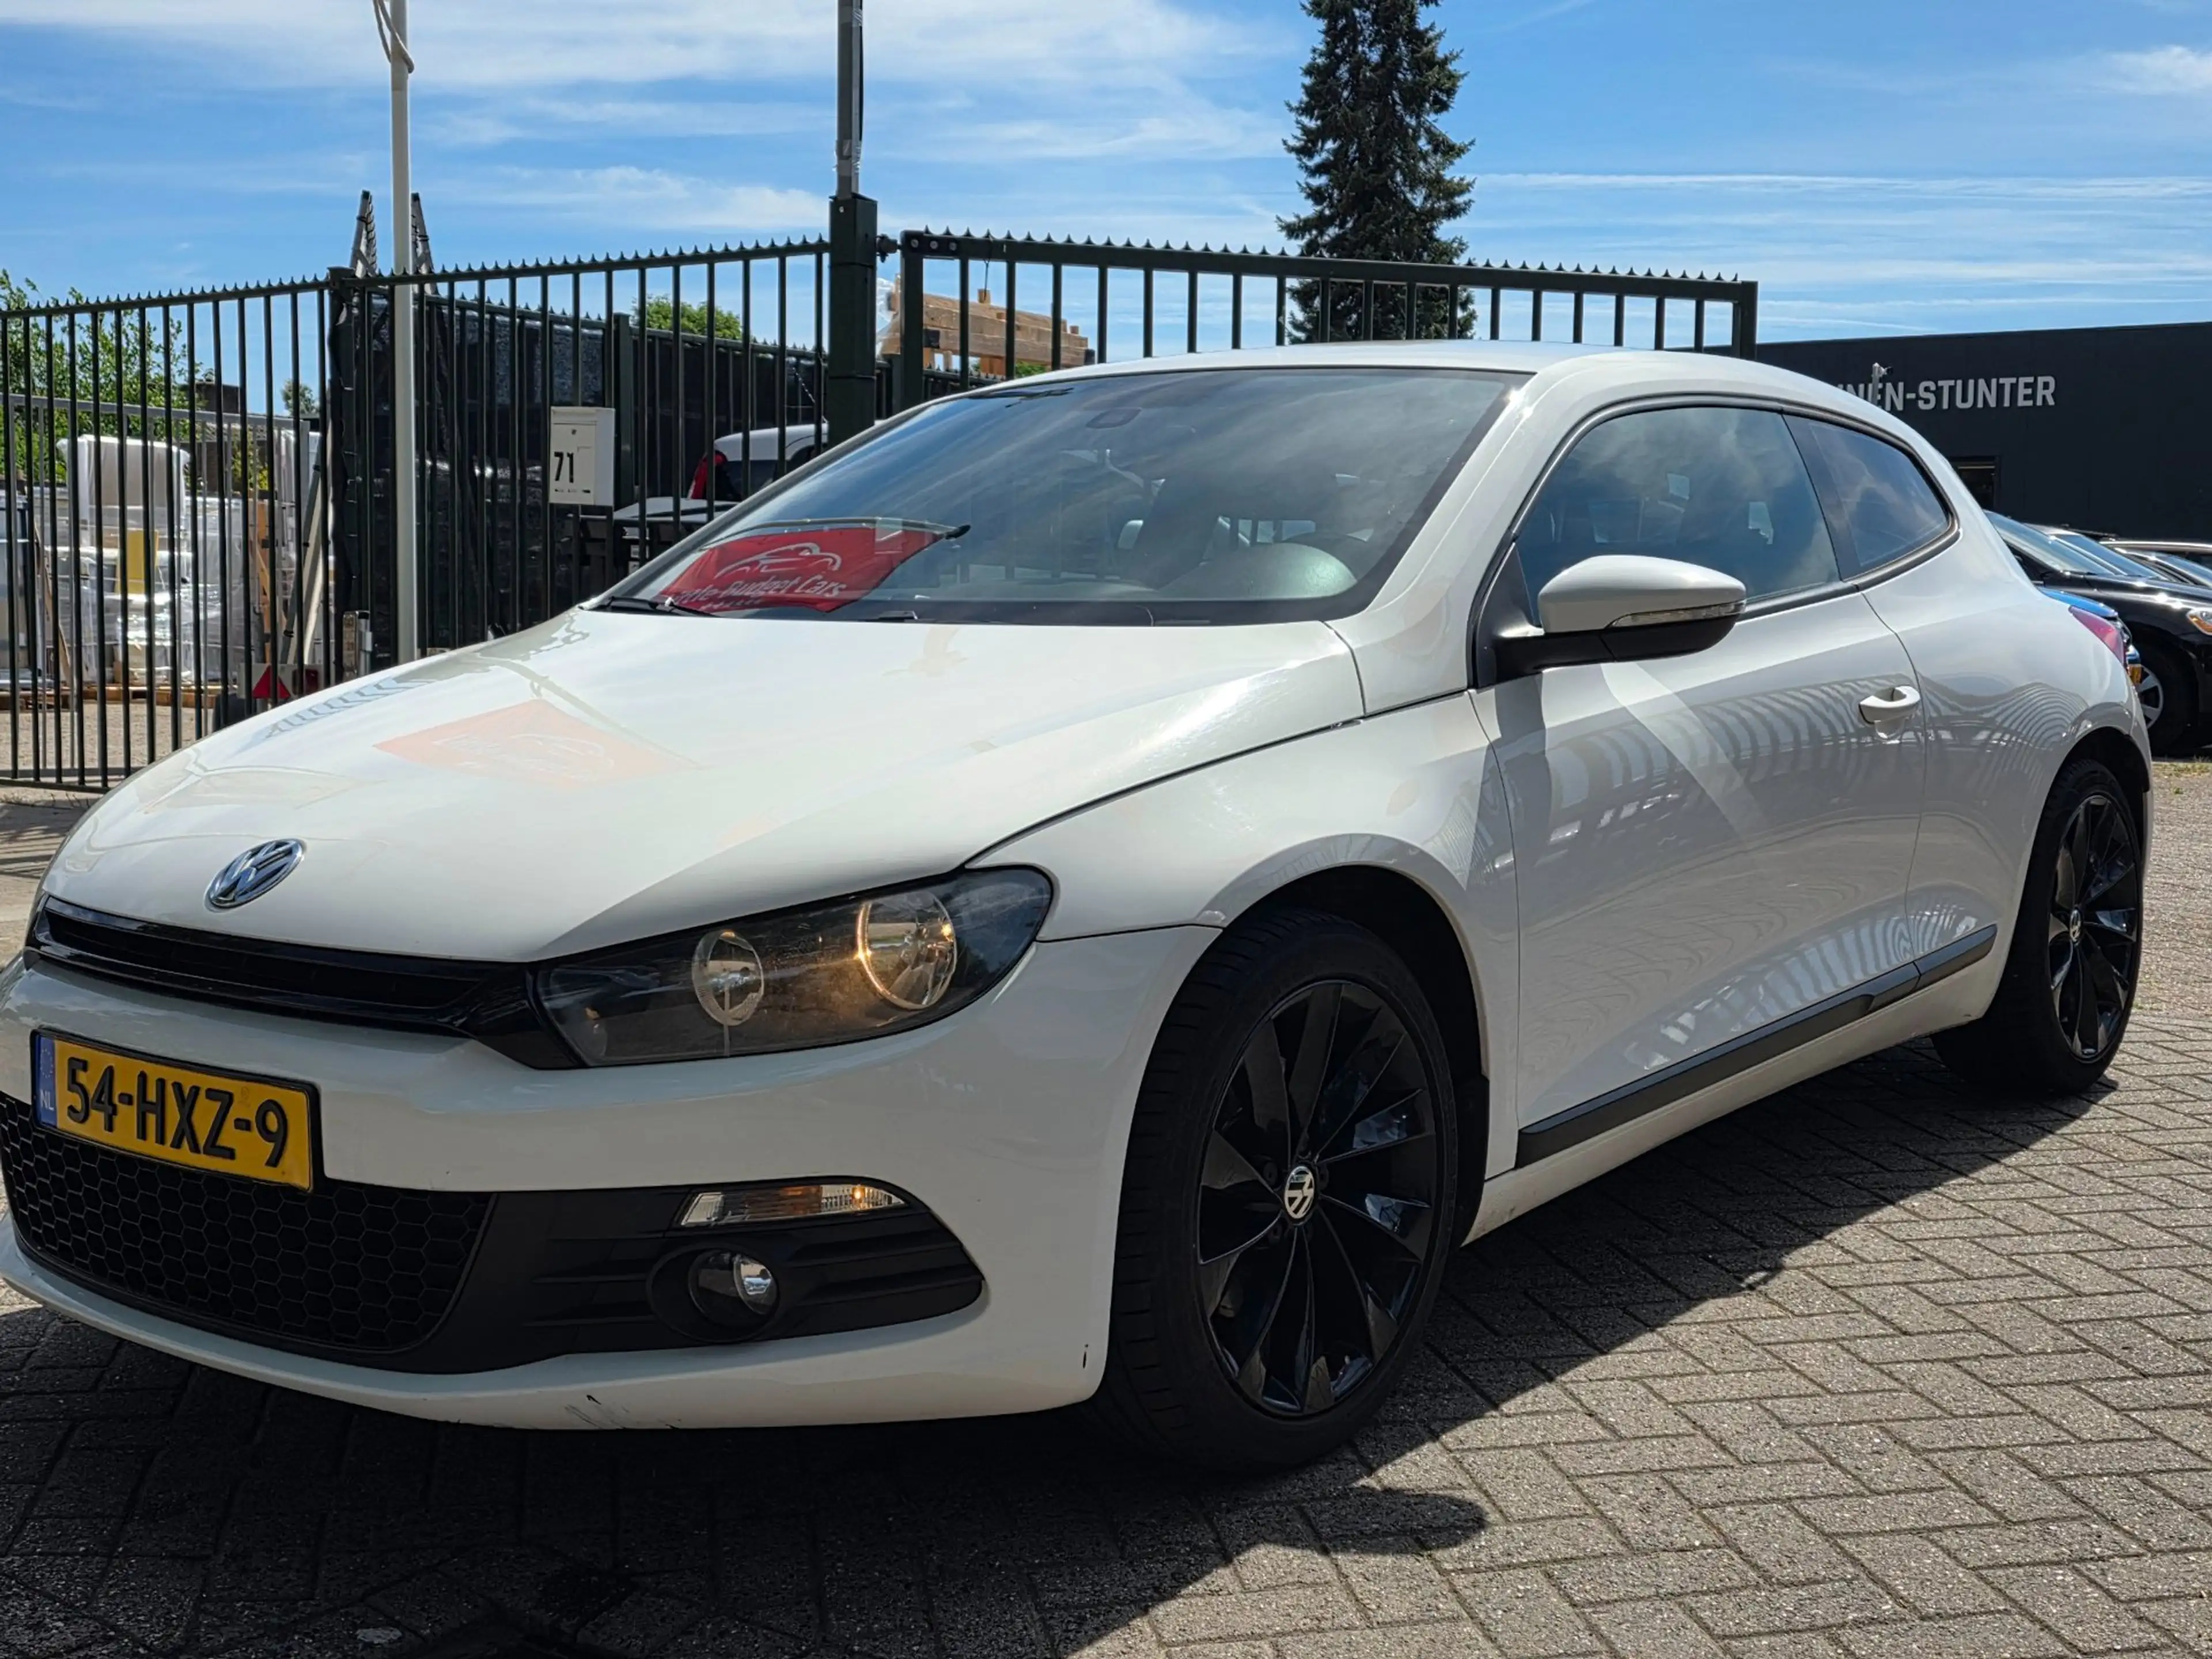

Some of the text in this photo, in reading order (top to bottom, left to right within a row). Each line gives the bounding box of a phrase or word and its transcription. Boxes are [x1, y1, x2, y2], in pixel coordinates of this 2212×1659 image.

[554, 451, 574, 483] 71
[794, 574, 847, 598] Cars
[39, 1089, 55, 1111] NL
[66, 1056, 289, 1168] 54-HXZ-9
